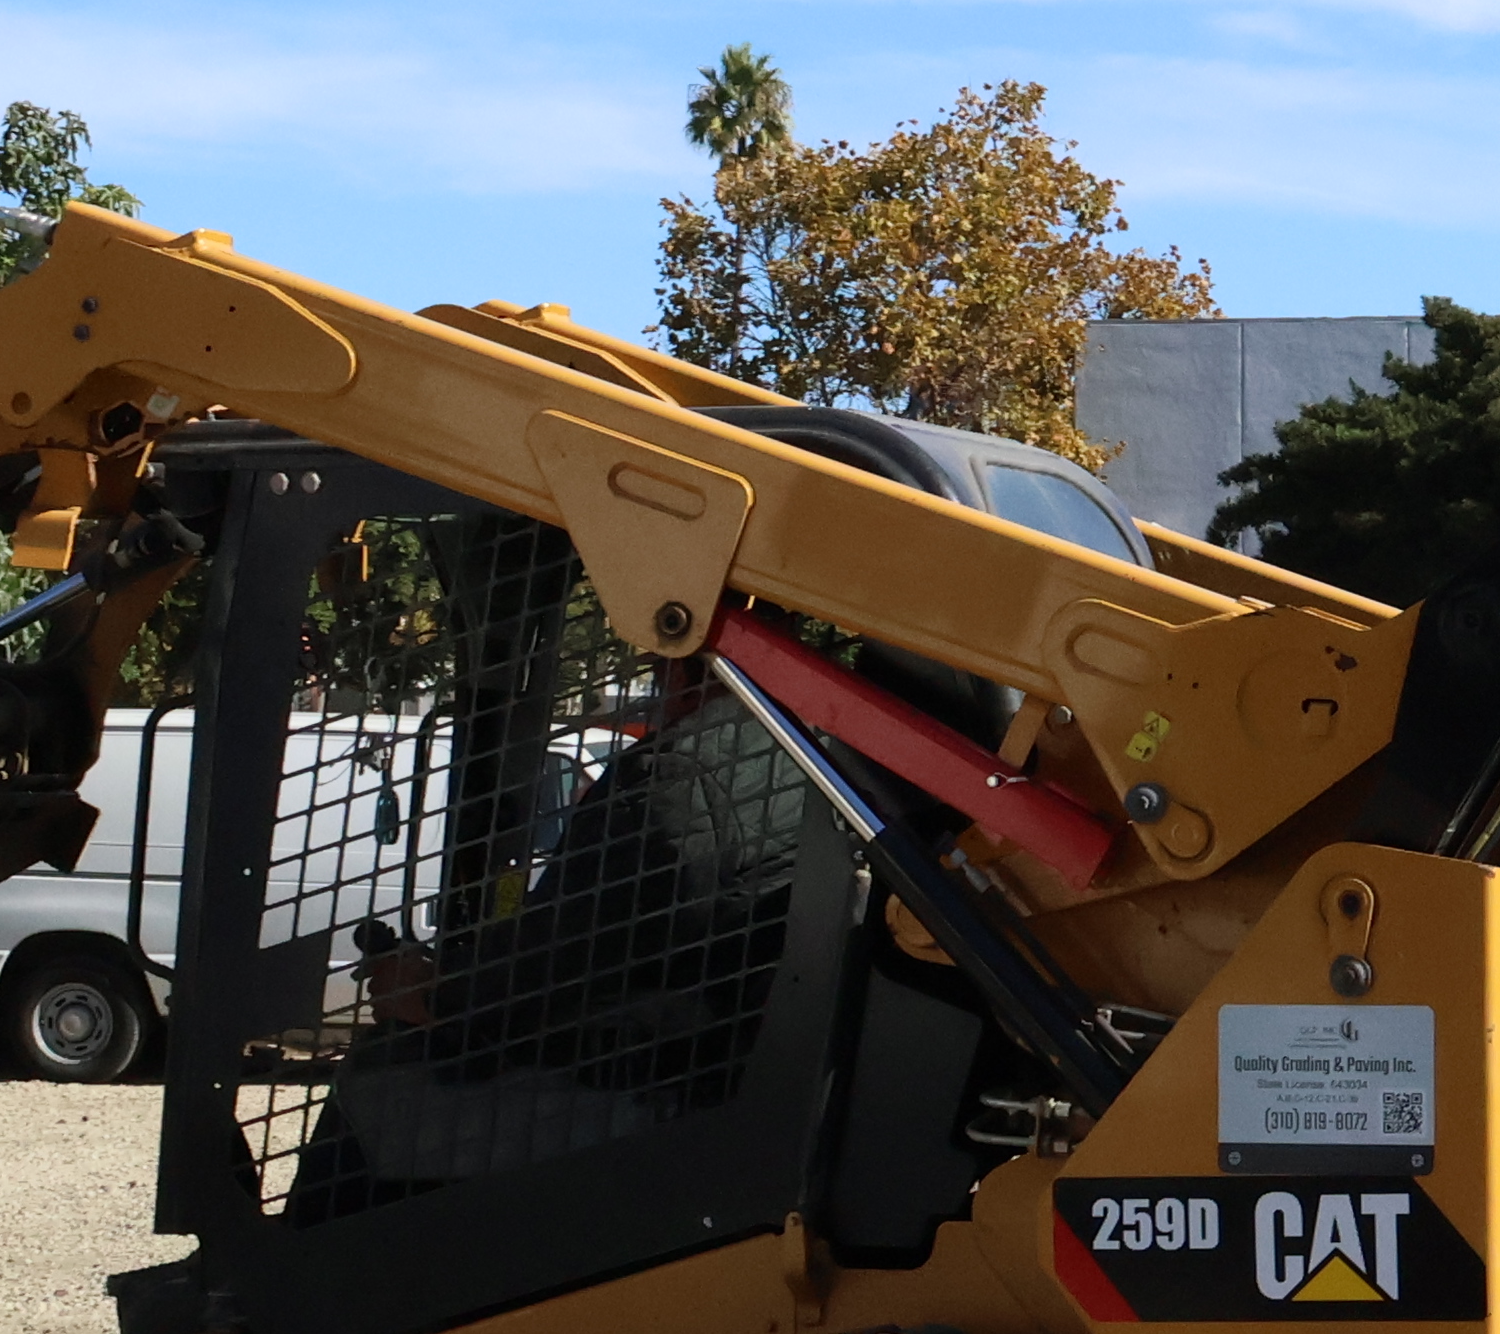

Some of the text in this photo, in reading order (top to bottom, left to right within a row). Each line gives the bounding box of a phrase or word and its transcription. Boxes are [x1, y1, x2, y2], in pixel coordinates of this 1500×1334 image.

[1234, 1055, 1416, 1075] Quality Grading & Paving Inc.
[1265, 1107, 1368, 1133] (310) 819-8072
[1091, 1191, 1410, 1301] 259D CAT
